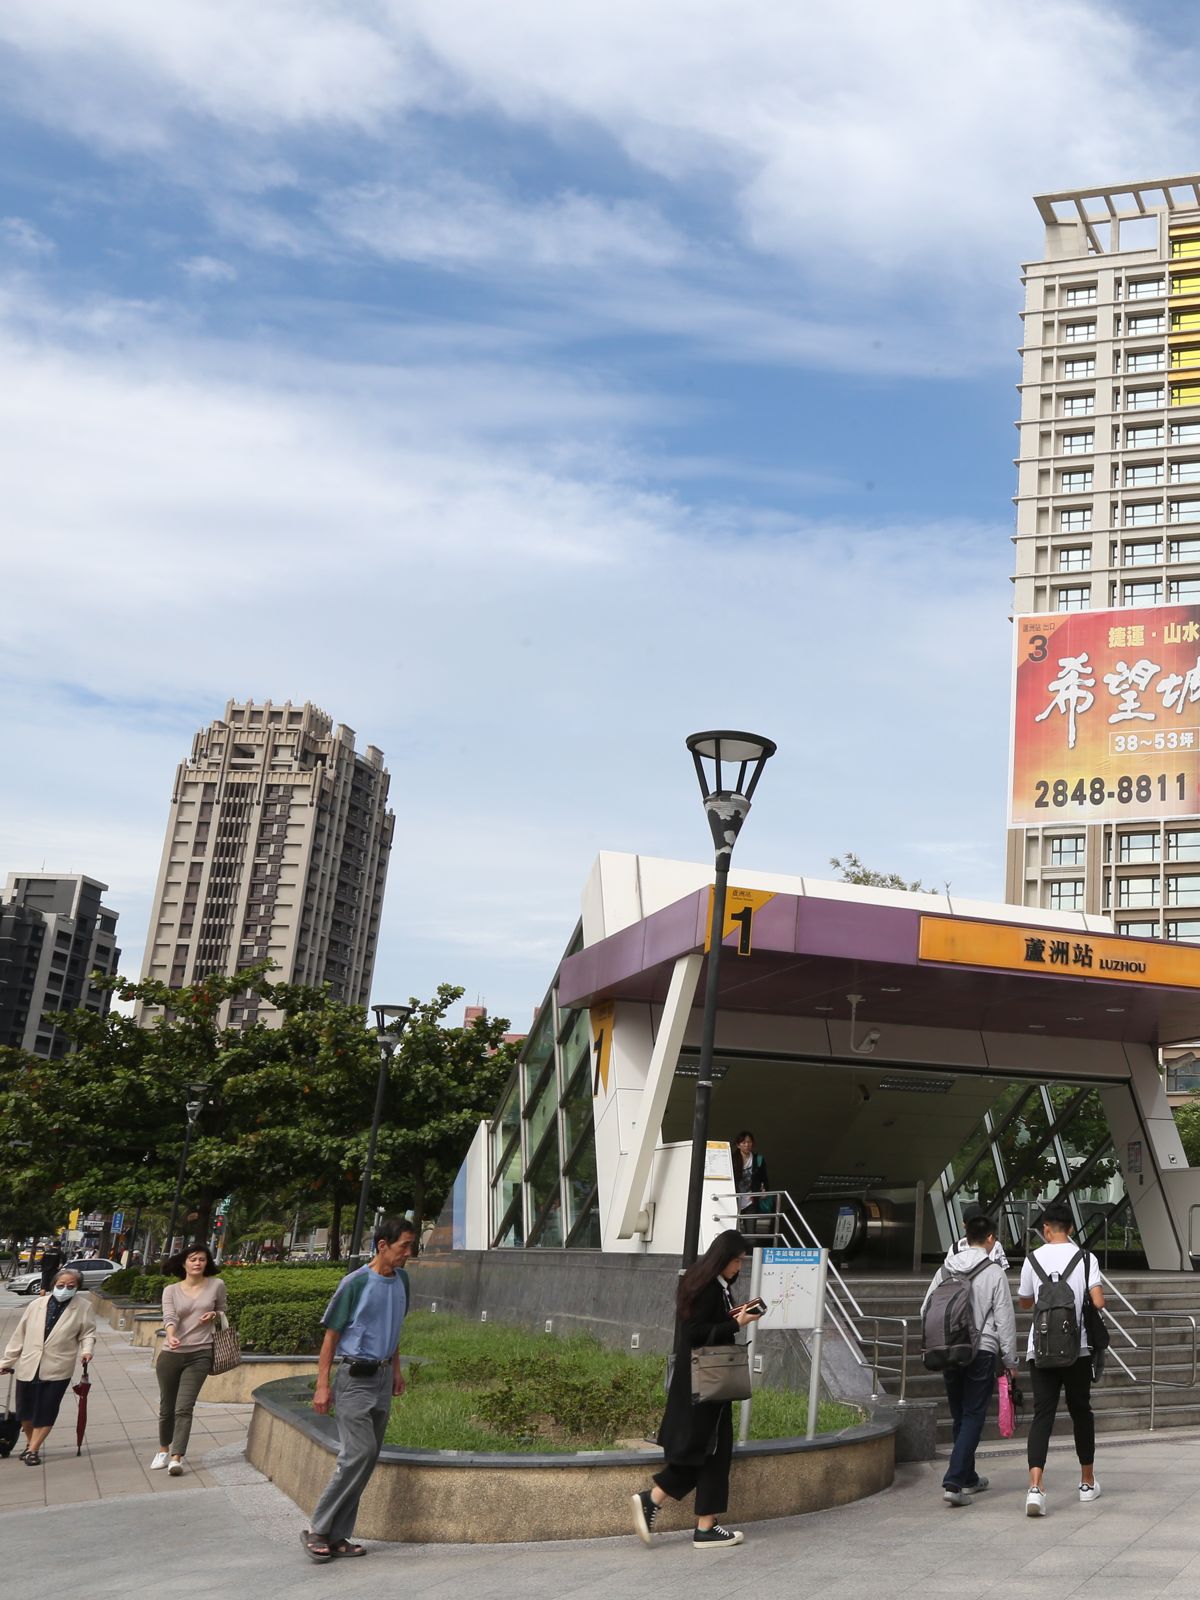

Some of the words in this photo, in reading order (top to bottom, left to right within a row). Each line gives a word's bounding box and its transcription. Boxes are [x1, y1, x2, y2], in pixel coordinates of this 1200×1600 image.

[1028, 634, 1048, 662] 3
[1035, 773, 1185, 808] 2848-8811
[730, 906, 752, 955] 1
[1024, 938, 1093, 968] 蘆洲站
[1099, 959, 1146, 973] LUZHOU
[593, 1028, 604, 1096] 1
